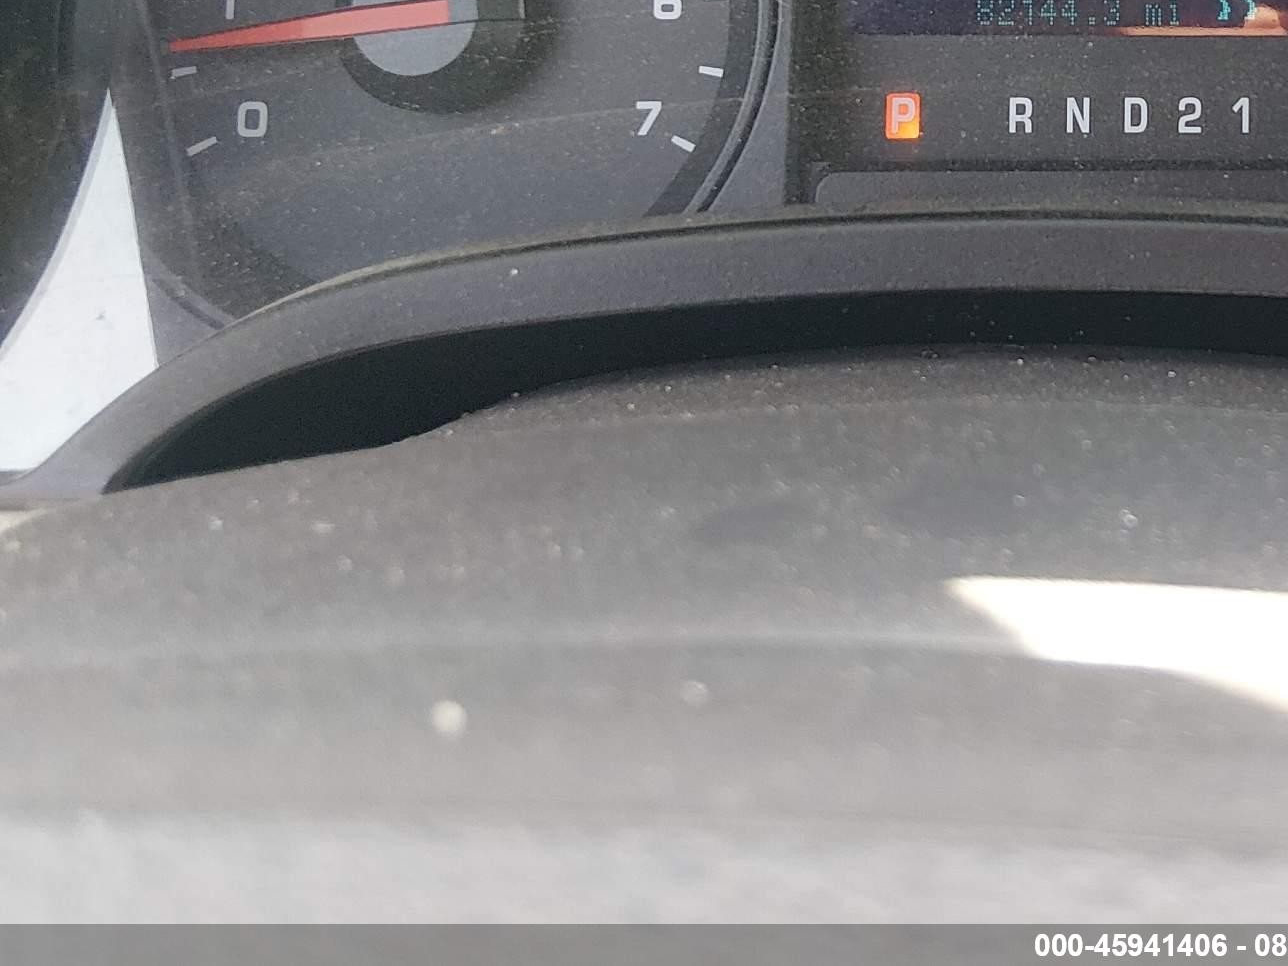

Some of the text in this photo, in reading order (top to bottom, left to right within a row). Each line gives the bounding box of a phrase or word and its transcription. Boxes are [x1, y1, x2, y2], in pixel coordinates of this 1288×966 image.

[237, 101, 268, 138] 0
[636, 101, 662, 137] 7
[891, 97, 1250, 135] P R N D 2 1
